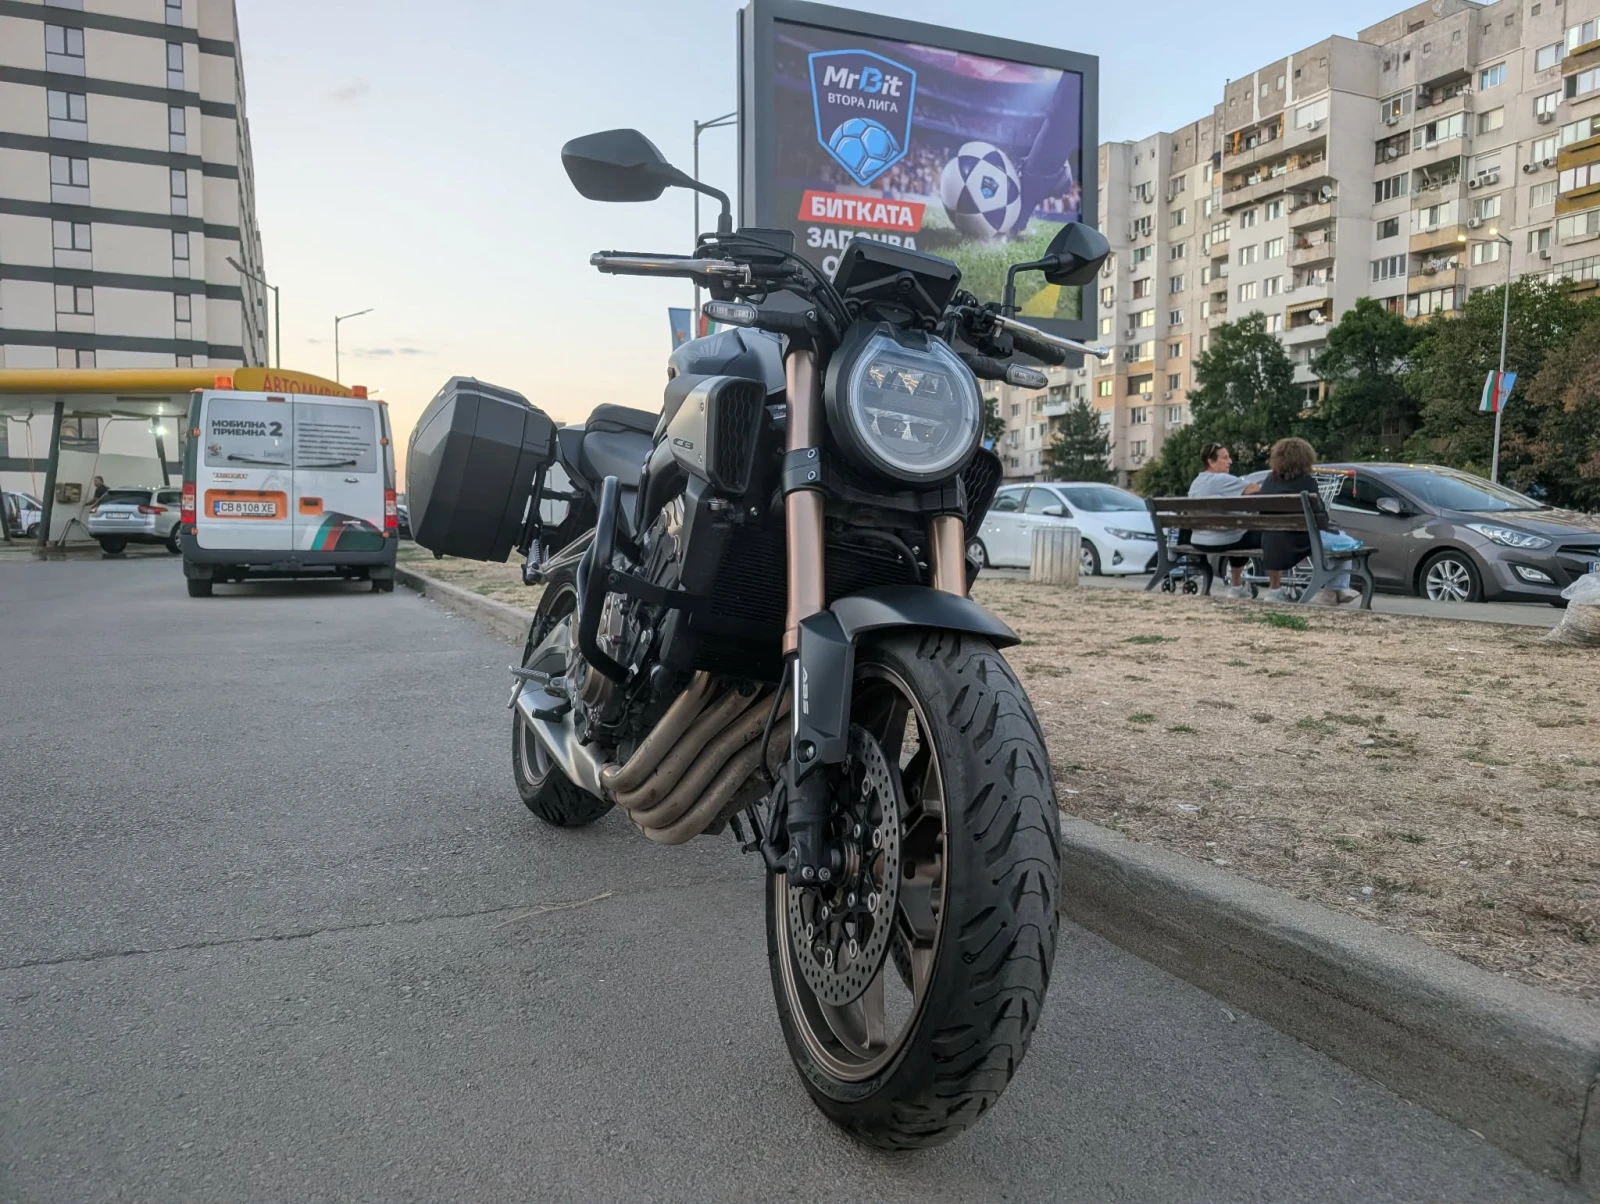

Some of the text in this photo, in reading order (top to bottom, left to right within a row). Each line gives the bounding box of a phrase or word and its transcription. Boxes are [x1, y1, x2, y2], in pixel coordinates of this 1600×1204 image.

[823, 65, 903, 97] MrBit
[827, 92, 898, 113] ВТОРА ЛИГА
[811, 196, 914, 227] БИТКАТА
[806, 226, 917, 252] ЗАПВА
[211, 419, 267, 429] МОБИЛНА
[213, 427, 266, 437] ПРИЕМНА
[268, 420, 283, 438] 2
[235, 503, 260, 513] 8108
